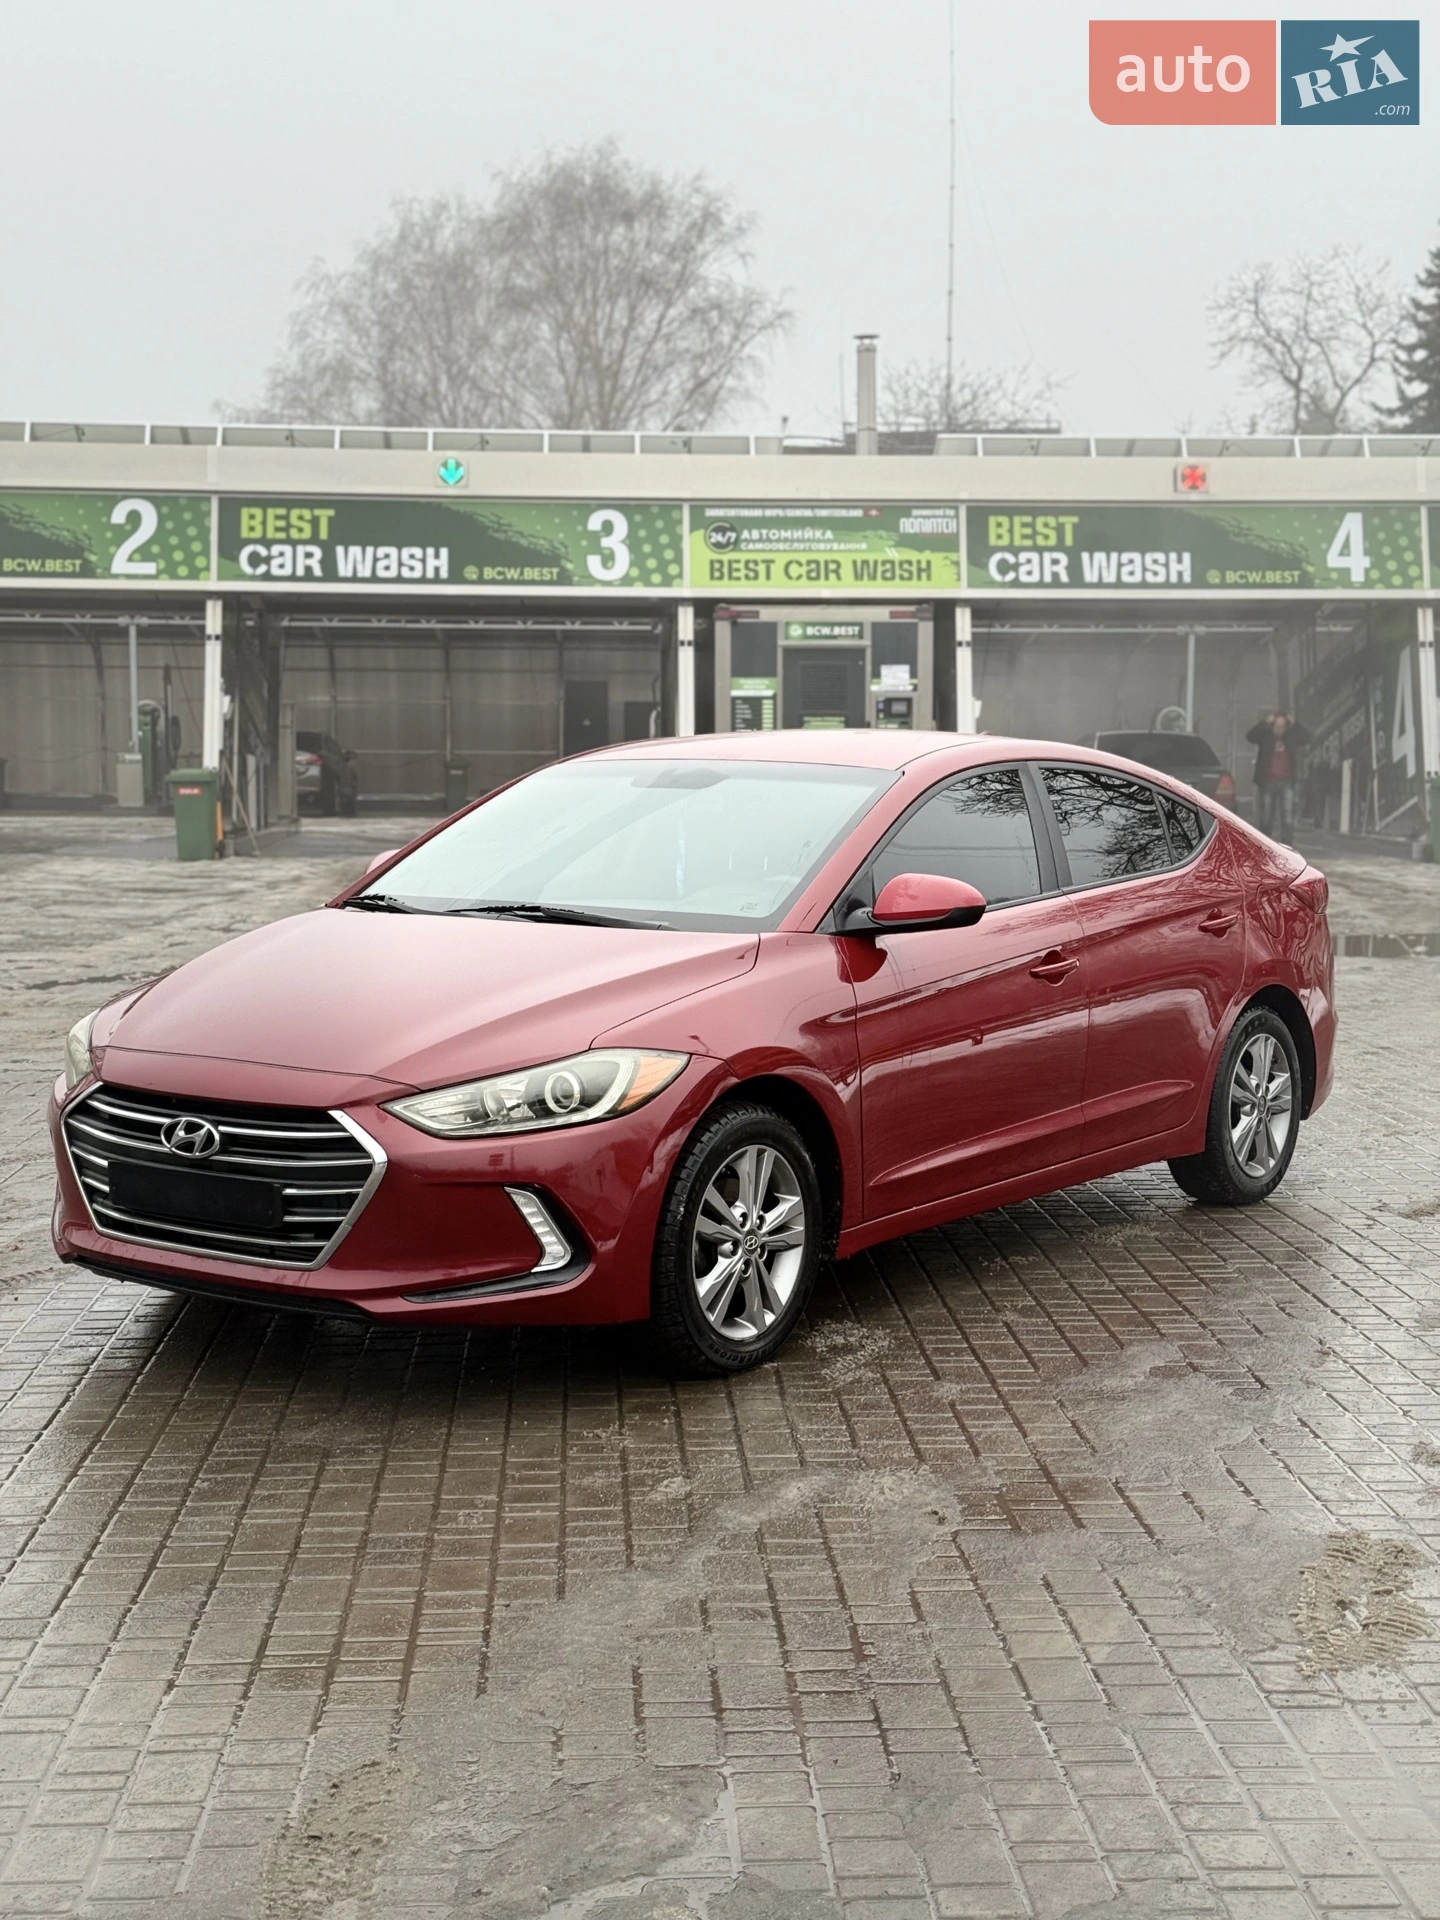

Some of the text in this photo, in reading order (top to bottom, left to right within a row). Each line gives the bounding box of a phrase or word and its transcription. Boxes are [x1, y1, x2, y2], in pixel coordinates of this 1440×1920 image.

[240, 507, 335, 541] BEST
[741, 527, 834, 540] АВТОМИЙКА
[988, 515, 1080, 547] BEST
[109, 497, 159, 576] 2
[585, 509, 631, 582] 3
[709, 531, 737, 545] 24/7
[740, 542, 867, 551] САМООБСЛУГОВУВАННЯ
[1325, 511, 1371, 582] 4
[2, 558, 82, 573] BCW.BEST
[483, 566, 560, 582] BCW.BEST
[708, 559, 776, 582] BEST
[1225, 570, 1301, 584] BCW.BEST
[805, 625, 861, 636] BCW.BEST
[1391, 643, 1416, 780] 4
